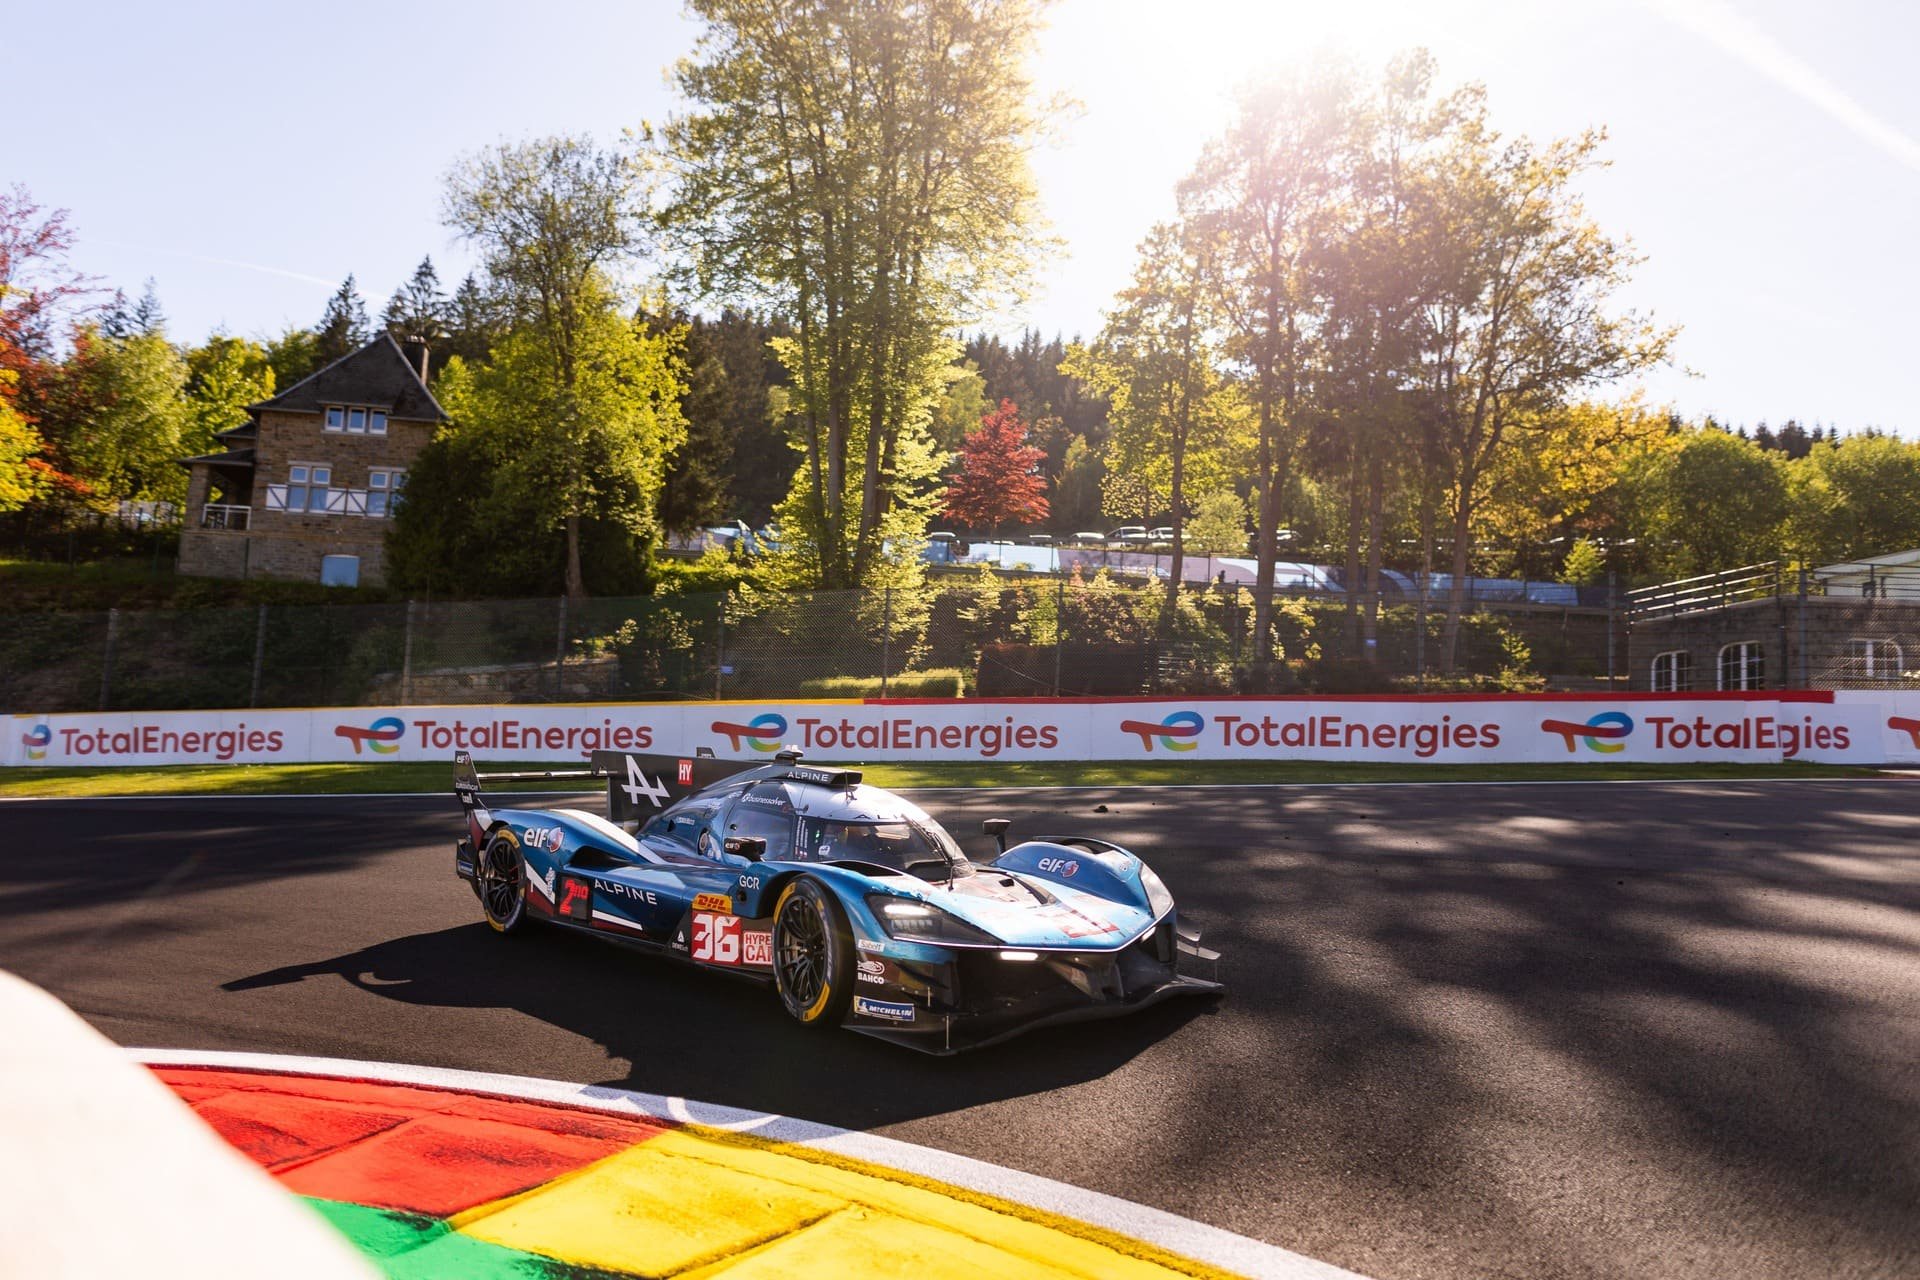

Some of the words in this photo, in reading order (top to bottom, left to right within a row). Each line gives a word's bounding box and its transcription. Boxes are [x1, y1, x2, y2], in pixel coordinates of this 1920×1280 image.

[60, 723, 284, 760] TotalEnergies
[413, 719, 653, 758] TotalEnergies
[796, 716, 1058, 757] TotalEnergies
[1213, 715, 1501, 758] TotalEnergies
[679, 763, 693, 782] HY
[787, 771, 829, 782] ALPINE
[523, 828, 549, 848] elf
[1038, 857, 1063, 873] elf
[739, 875, 760, 890] GCR
[594, 879, 658, 906] ALPINE
[697, 894, 727, 911] DHL
[693, 913, 740, 962] 36
[744, 933, 772, 945] HYPE
[857, 972, 885, 985] BAHCO
[869, 1006, 912, 1017] MICHELIN
